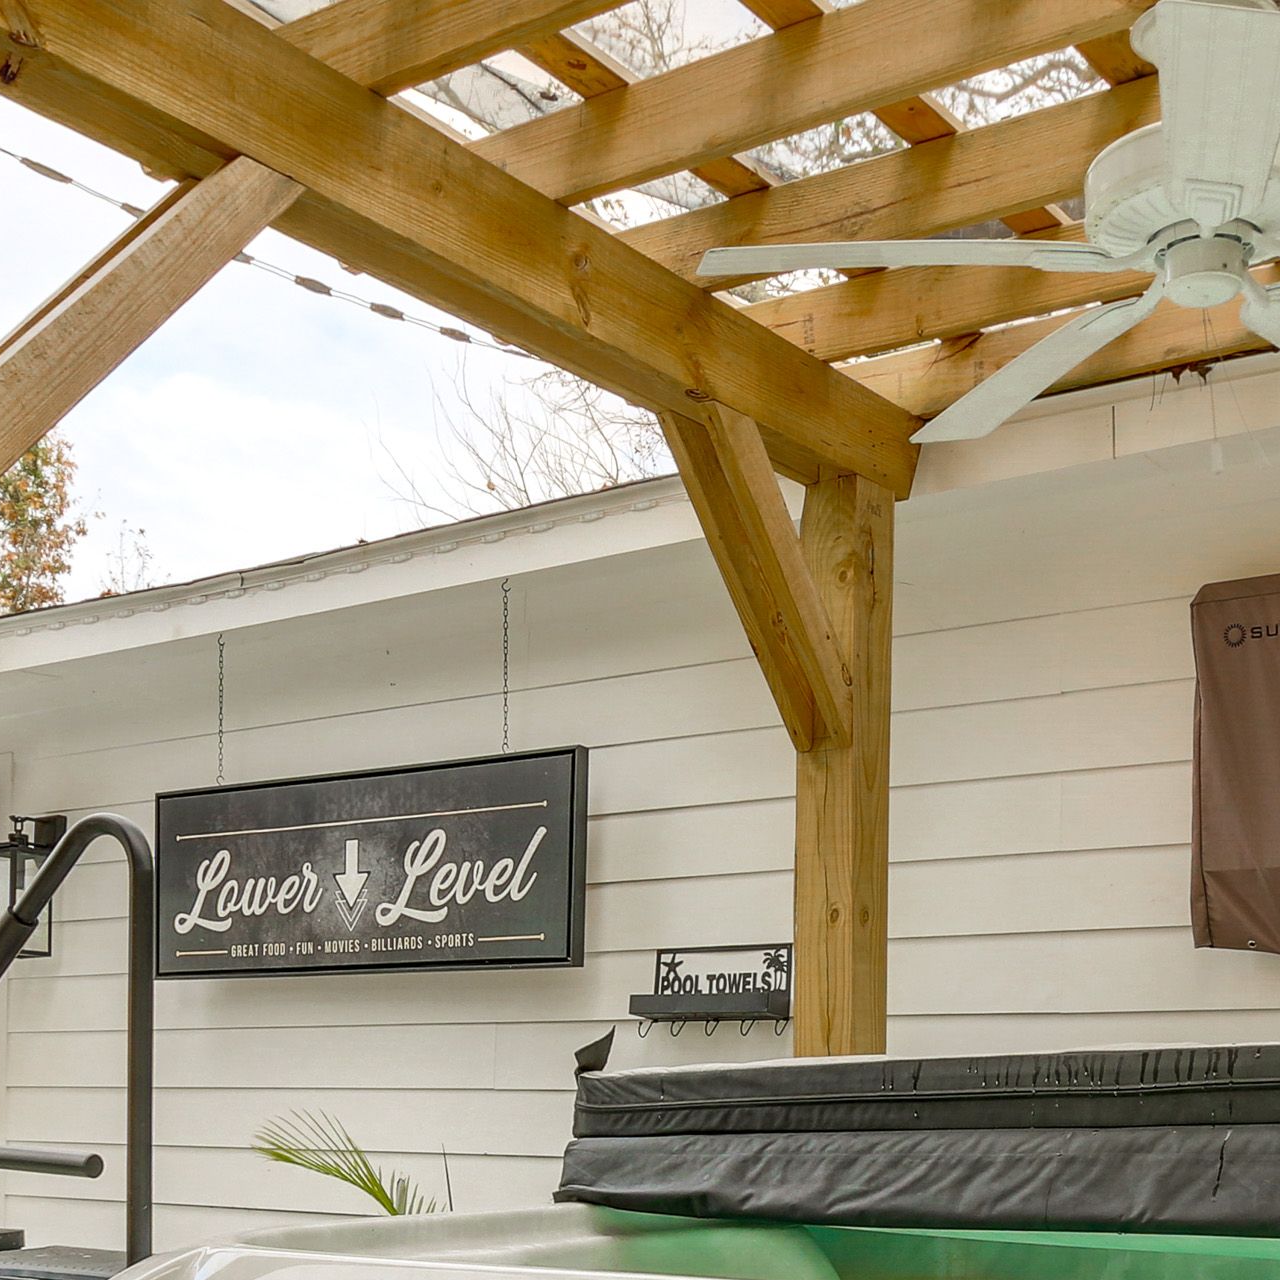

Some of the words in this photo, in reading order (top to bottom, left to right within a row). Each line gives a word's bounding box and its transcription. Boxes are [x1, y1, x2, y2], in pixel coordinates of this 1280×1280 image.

[174, 849, 322, 935] Lower
[375, 825, 547, 927] Level
[230, 943, 259, 957] GREAT
[262, 942, 286, 956] FOOD
[296, 941, 314, 955] FUN
[324, 939, 360, 954] MOVIES
[371, 935, 423, 952] BILLIARDS
[434, 932, 475, 948] SPORTS
[661, 974, 703, 995] POOL
[707, 971, 772, 995] TOWELS
